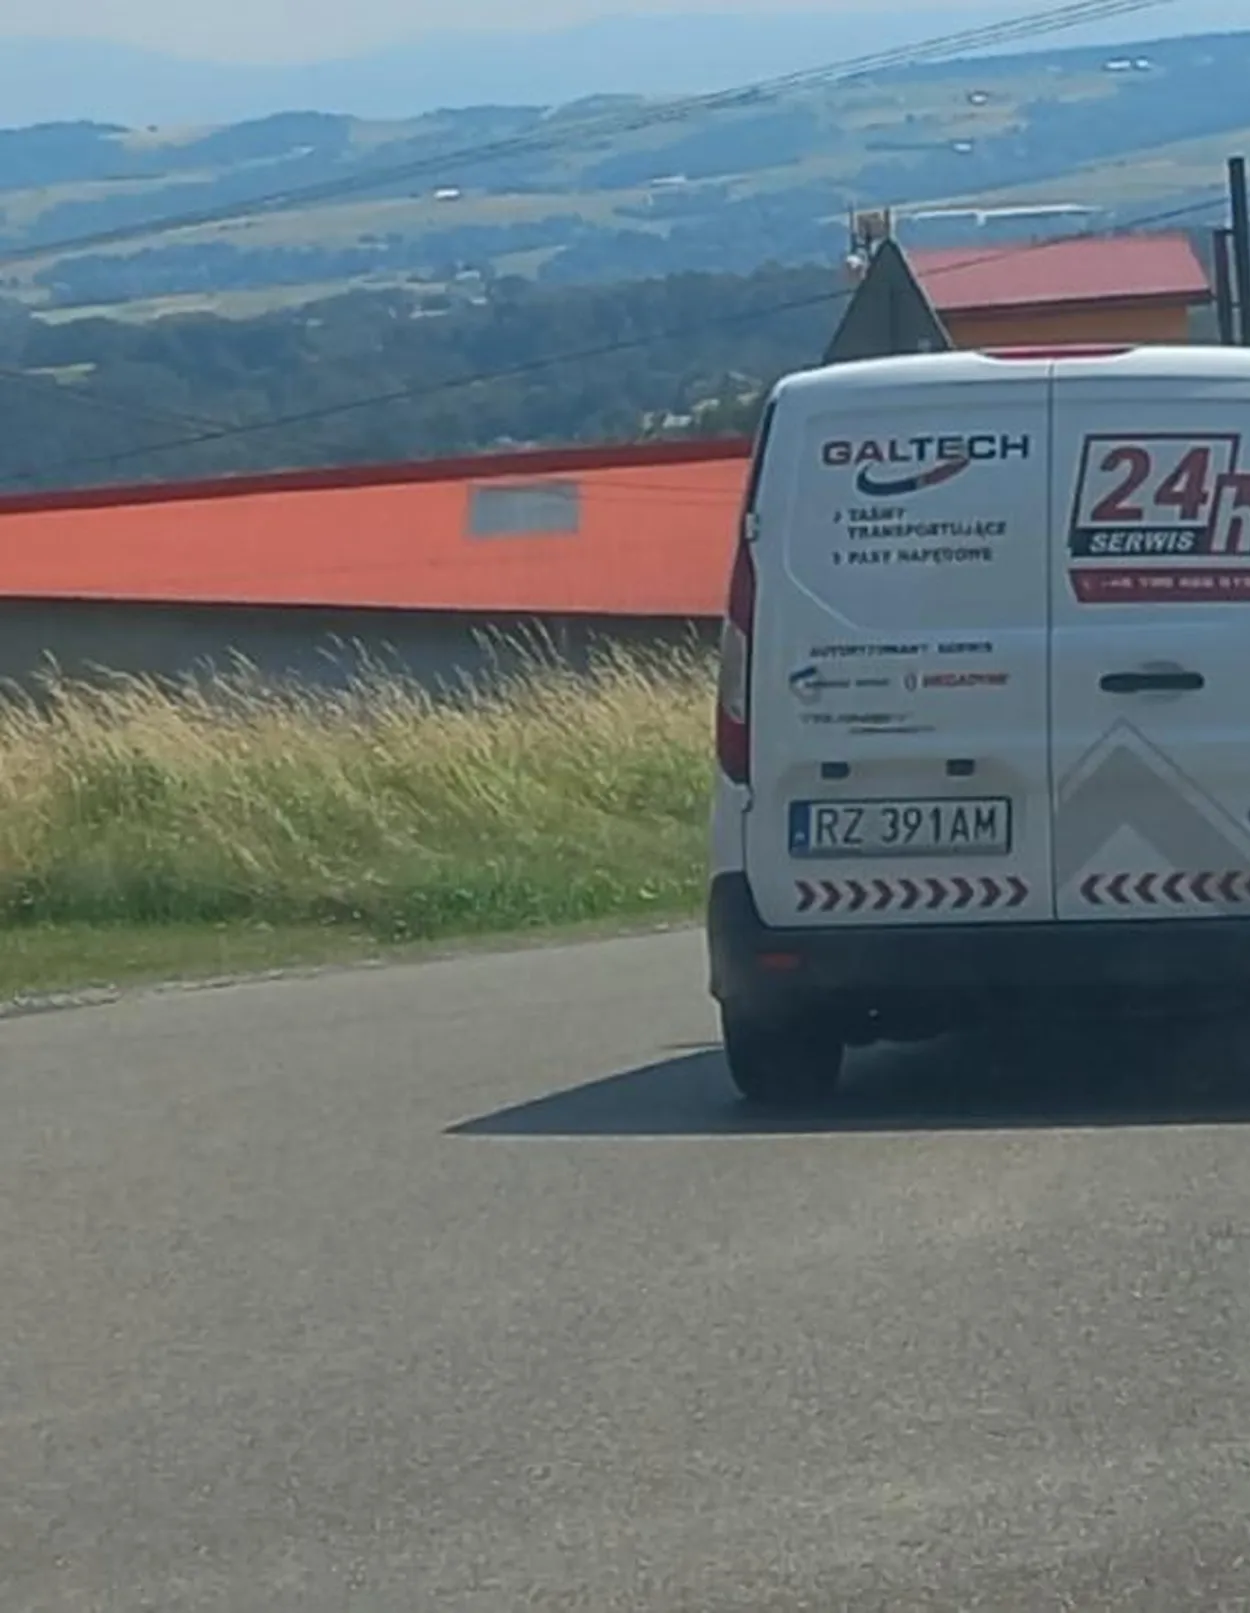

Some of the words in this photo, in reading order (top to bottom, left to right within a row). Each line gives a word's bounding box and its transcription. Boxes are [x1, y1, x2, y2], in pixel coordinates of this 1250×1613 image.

[821, 434, 1030, 466] GALTECH
[1089, 531, 1196, 553] SERWIS
[816, 807, 865, 845] RZ
[881, 805, 998, 844] 391AM
